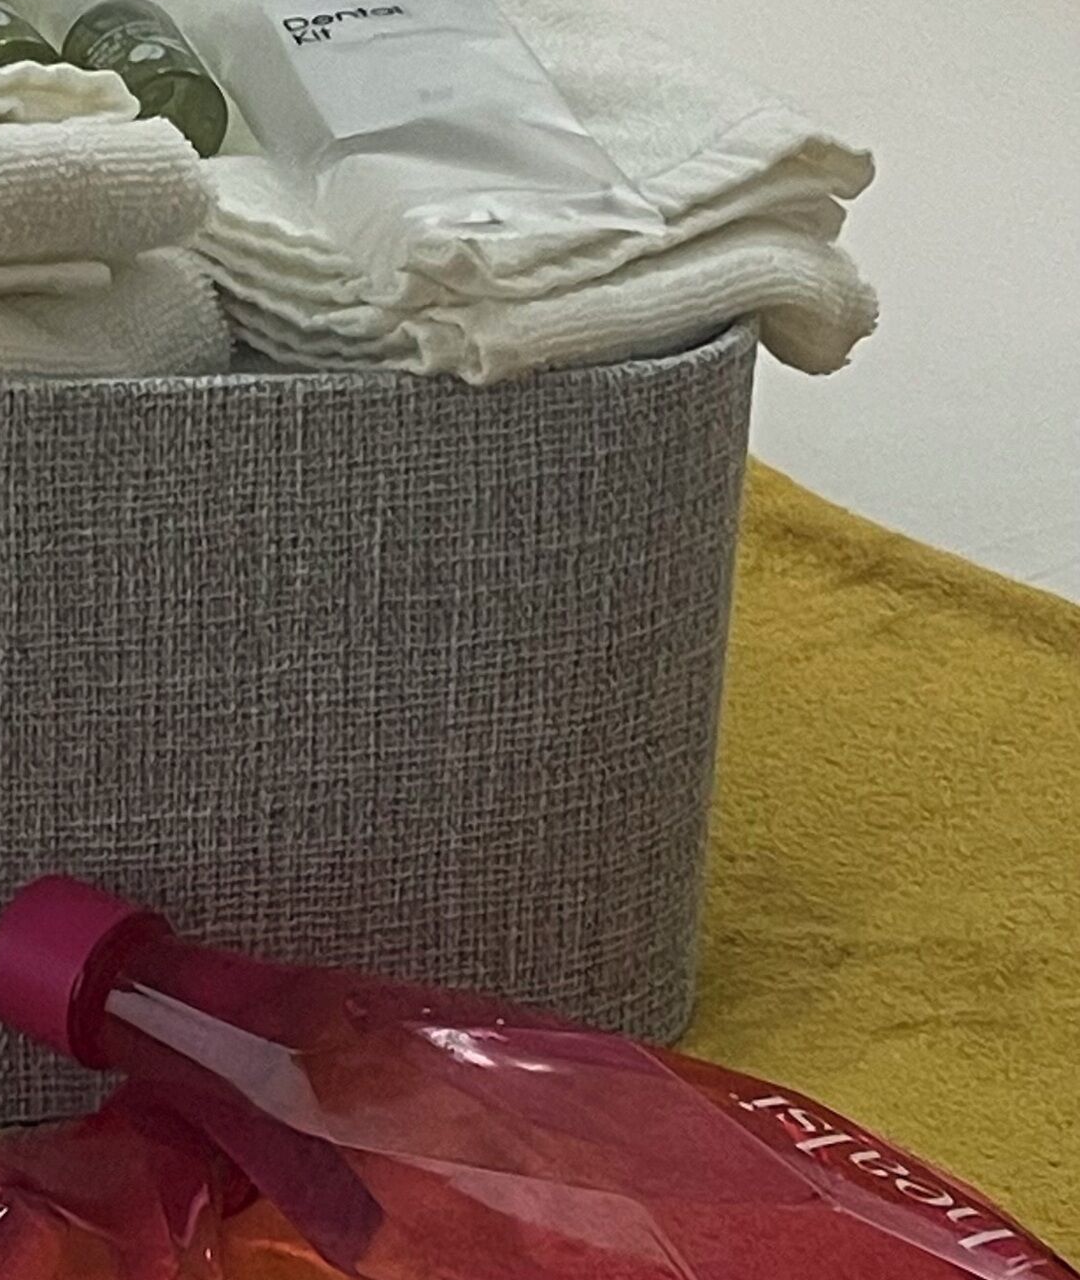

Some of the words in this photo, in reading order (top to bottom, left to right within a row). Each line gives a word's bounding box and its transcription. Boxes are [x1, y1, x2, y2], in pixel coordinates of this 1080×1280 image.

[282, 5, 406, 32] Dental
[291, 27, 332, 46] Kit
[732, 1092, 1017, 1252] healsi
